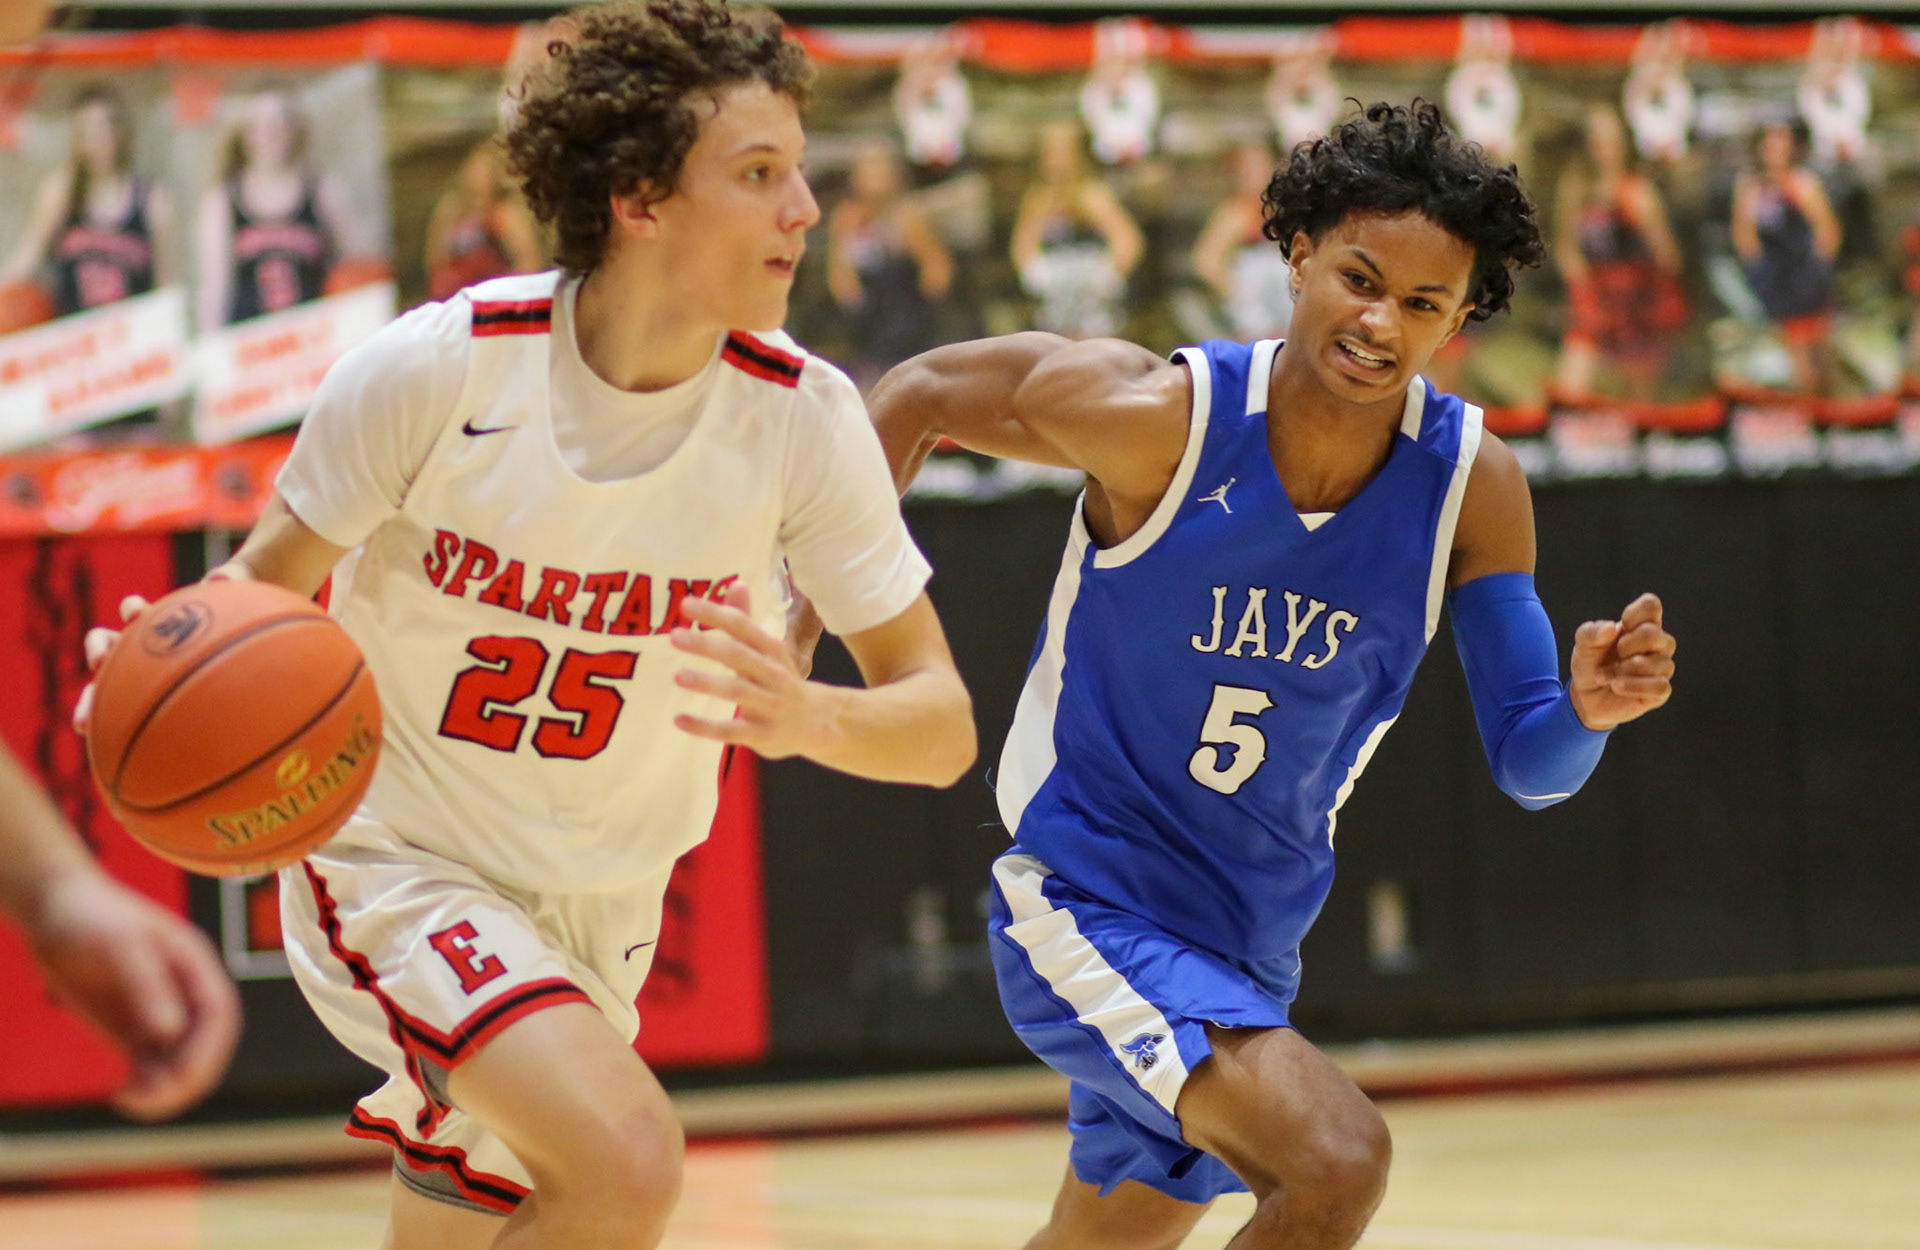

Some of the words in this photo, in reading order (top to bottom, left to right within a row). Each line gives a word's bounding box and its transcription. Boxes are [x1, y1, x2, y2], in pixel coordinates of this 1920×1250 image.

[1191, 585, 1360, 670] JAYS
[437, 634, 640, 761] 25
[1187, 681, 1278, 795] 5
[207, 724, 374, 851] SPALDING
[427, 919, 508, 996] E
